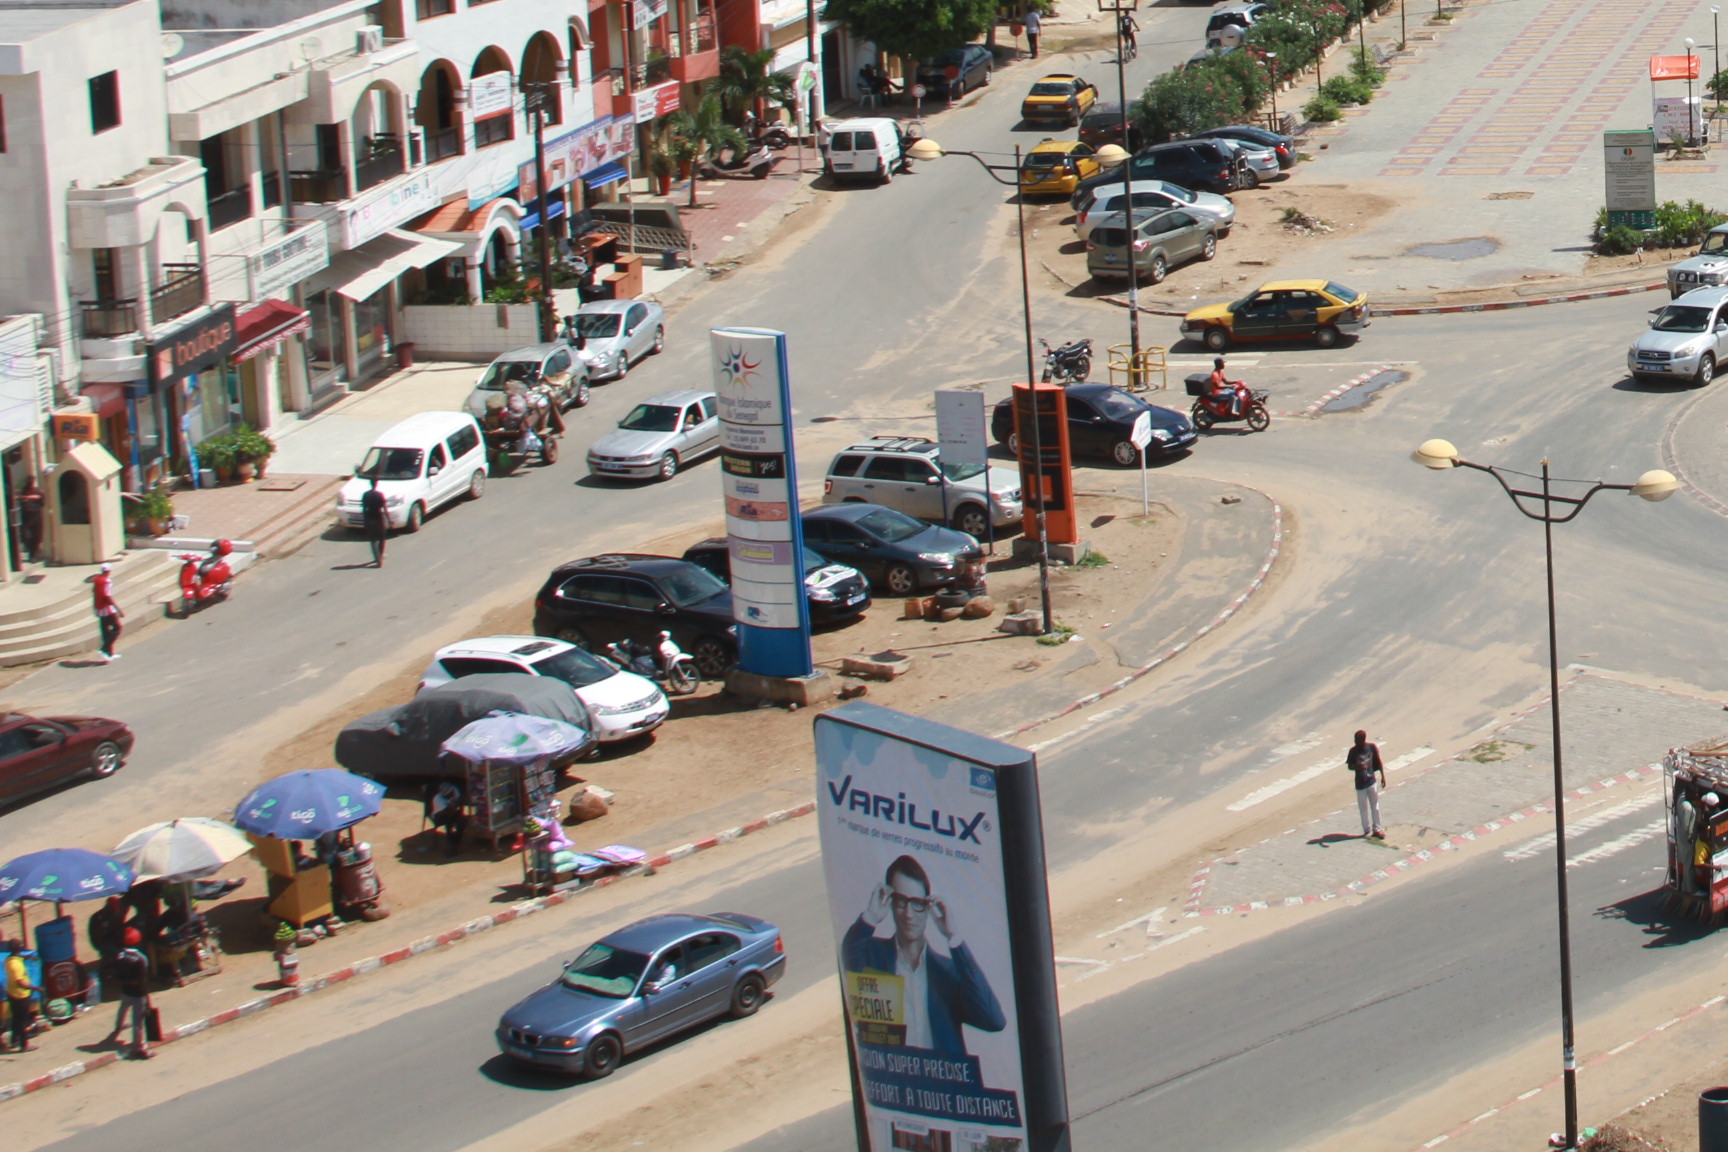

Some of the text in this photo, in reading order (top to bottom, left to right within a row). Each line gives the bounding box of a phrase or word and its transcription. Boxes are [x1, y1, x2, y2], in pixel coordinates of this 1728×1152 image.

[174, 320, 231, 366] boutique
[60, 419, 89, 434] Ria
[290, 807, 317, 824] tigo
[871, 827, 881, 839] de
[904, 835, 944, 855] progressifs
[857, 975, 880, 993] OFFRE
[887, 1053, 921, 1076] SUPER
[917, 1089, 954, 1113] TOUTE
[956, 1094, 1016, 1120] DISTANCE
